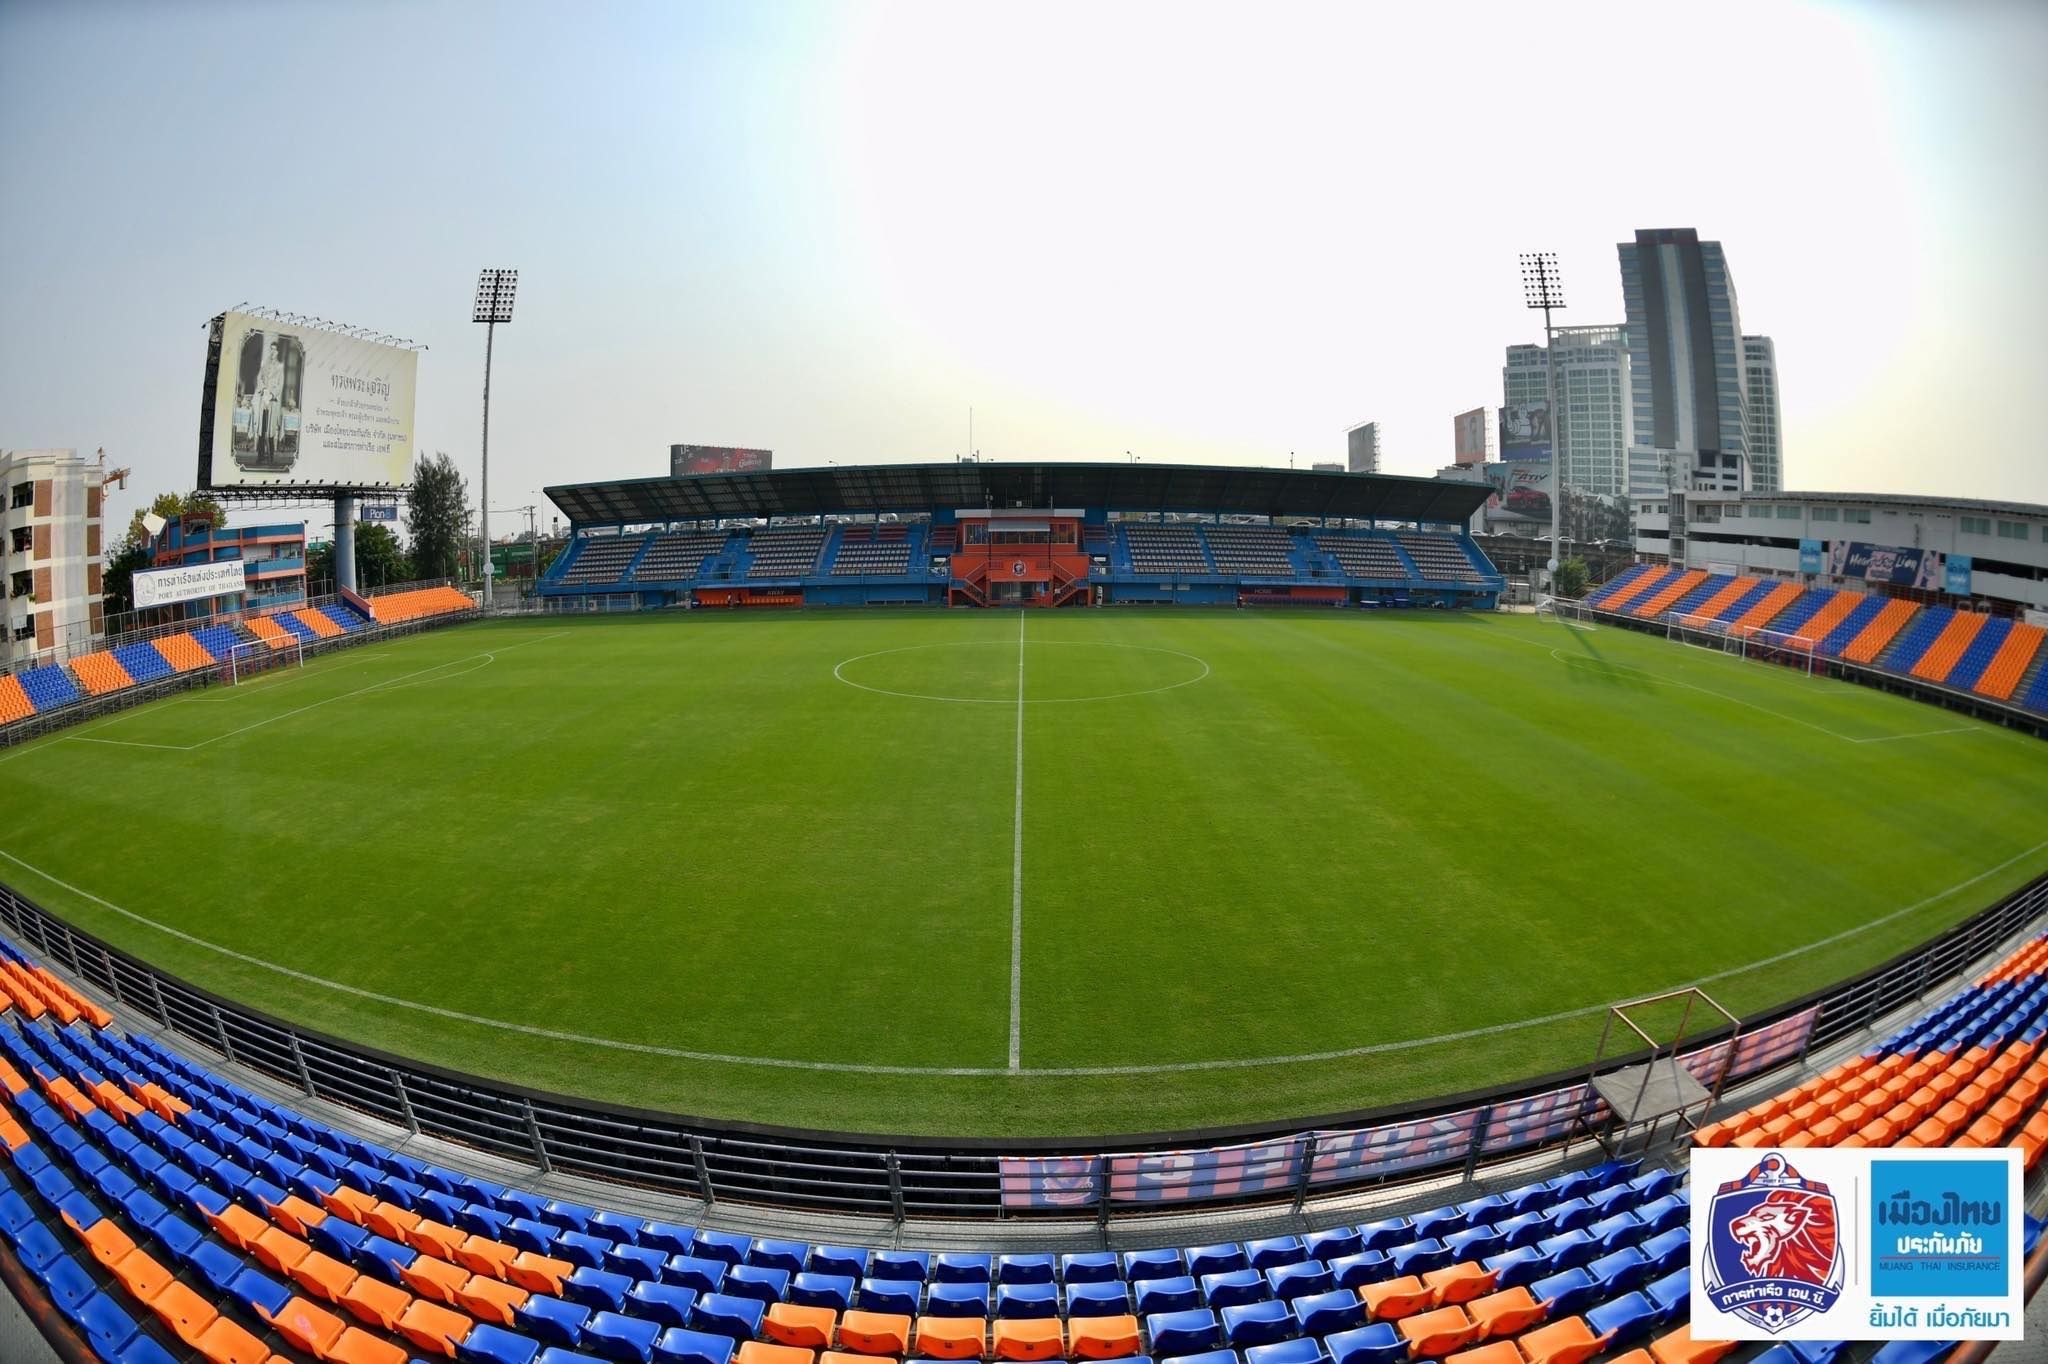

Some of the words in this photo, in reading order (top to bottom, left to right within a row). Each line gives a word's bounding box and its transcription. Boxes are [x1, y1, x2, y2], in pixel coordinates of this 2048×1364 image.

[158, 592, 173, 600] PORT
[176, 586, 206, 598] AUTHORITY
[208, 584, 216, 592] OF
[218, 581, 244, 591] THAILAND
